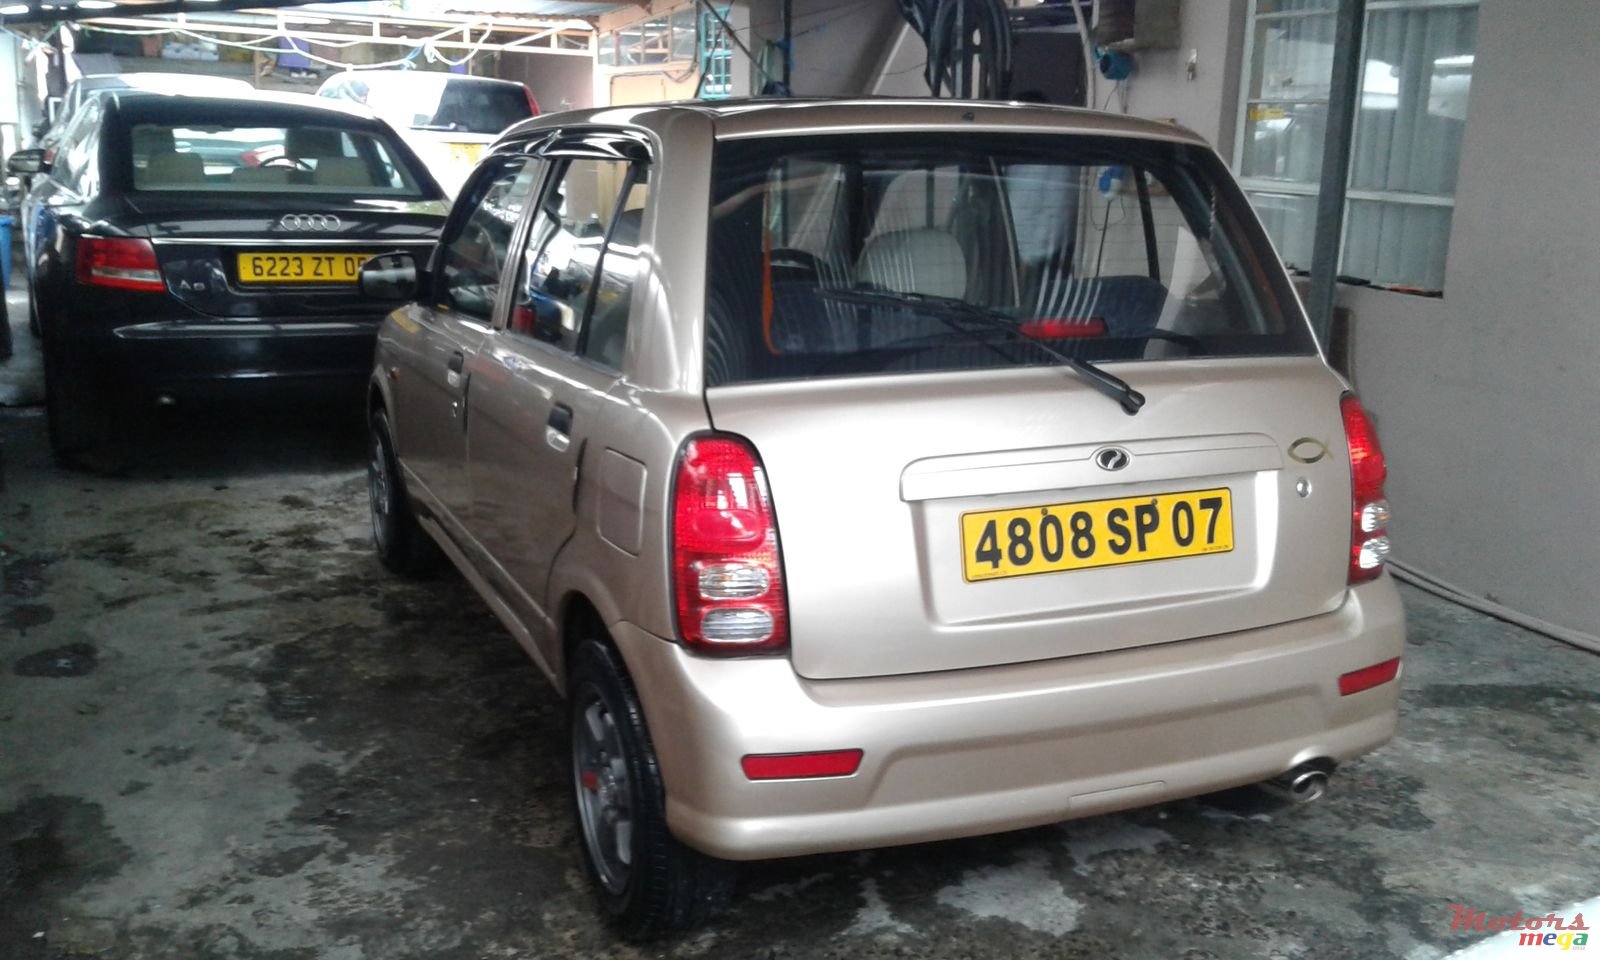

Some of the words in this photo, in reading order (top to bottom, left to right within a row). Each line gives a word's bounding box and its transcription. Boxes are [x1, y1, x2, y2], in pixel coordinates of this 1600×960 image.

[252, 256, 303, 277] 6223
[312, 256, 335, 276] ZT
[975, 511, 1096, 569] 4808
[1106, 500, 1160, 555] SP
[1171, 496, 1223, 547] 07
